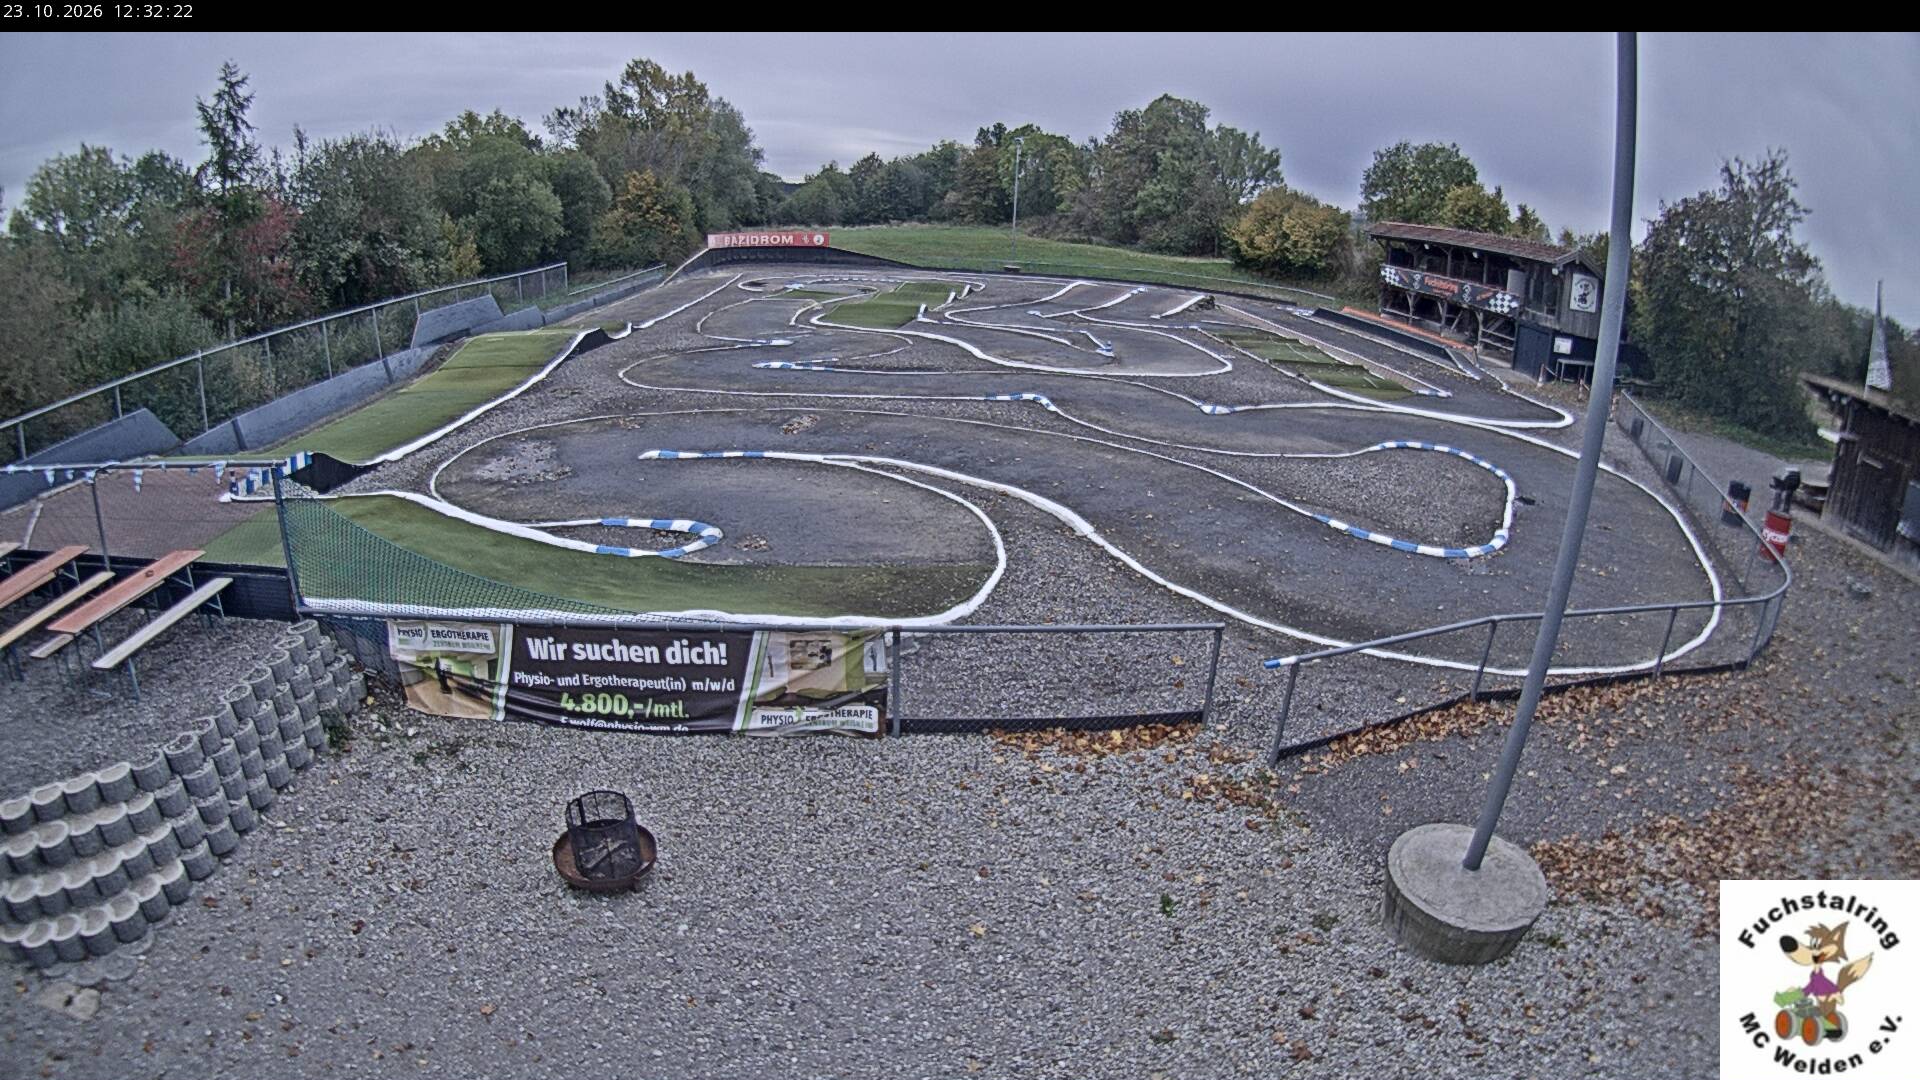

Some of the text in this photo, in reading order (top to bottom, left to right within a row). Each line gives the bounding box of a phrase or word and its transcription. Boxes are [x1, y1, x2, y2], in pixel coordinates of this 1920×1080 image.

[430, 629, 490, 641] ERGOTHERAPIE
[525, 637, 728, 666] Wir suchen dich!
[513, 671, 735, 692] Physio- und Ergotherapeut(in) m/w/d
[761, 714, 794, 725] PHYSIO
